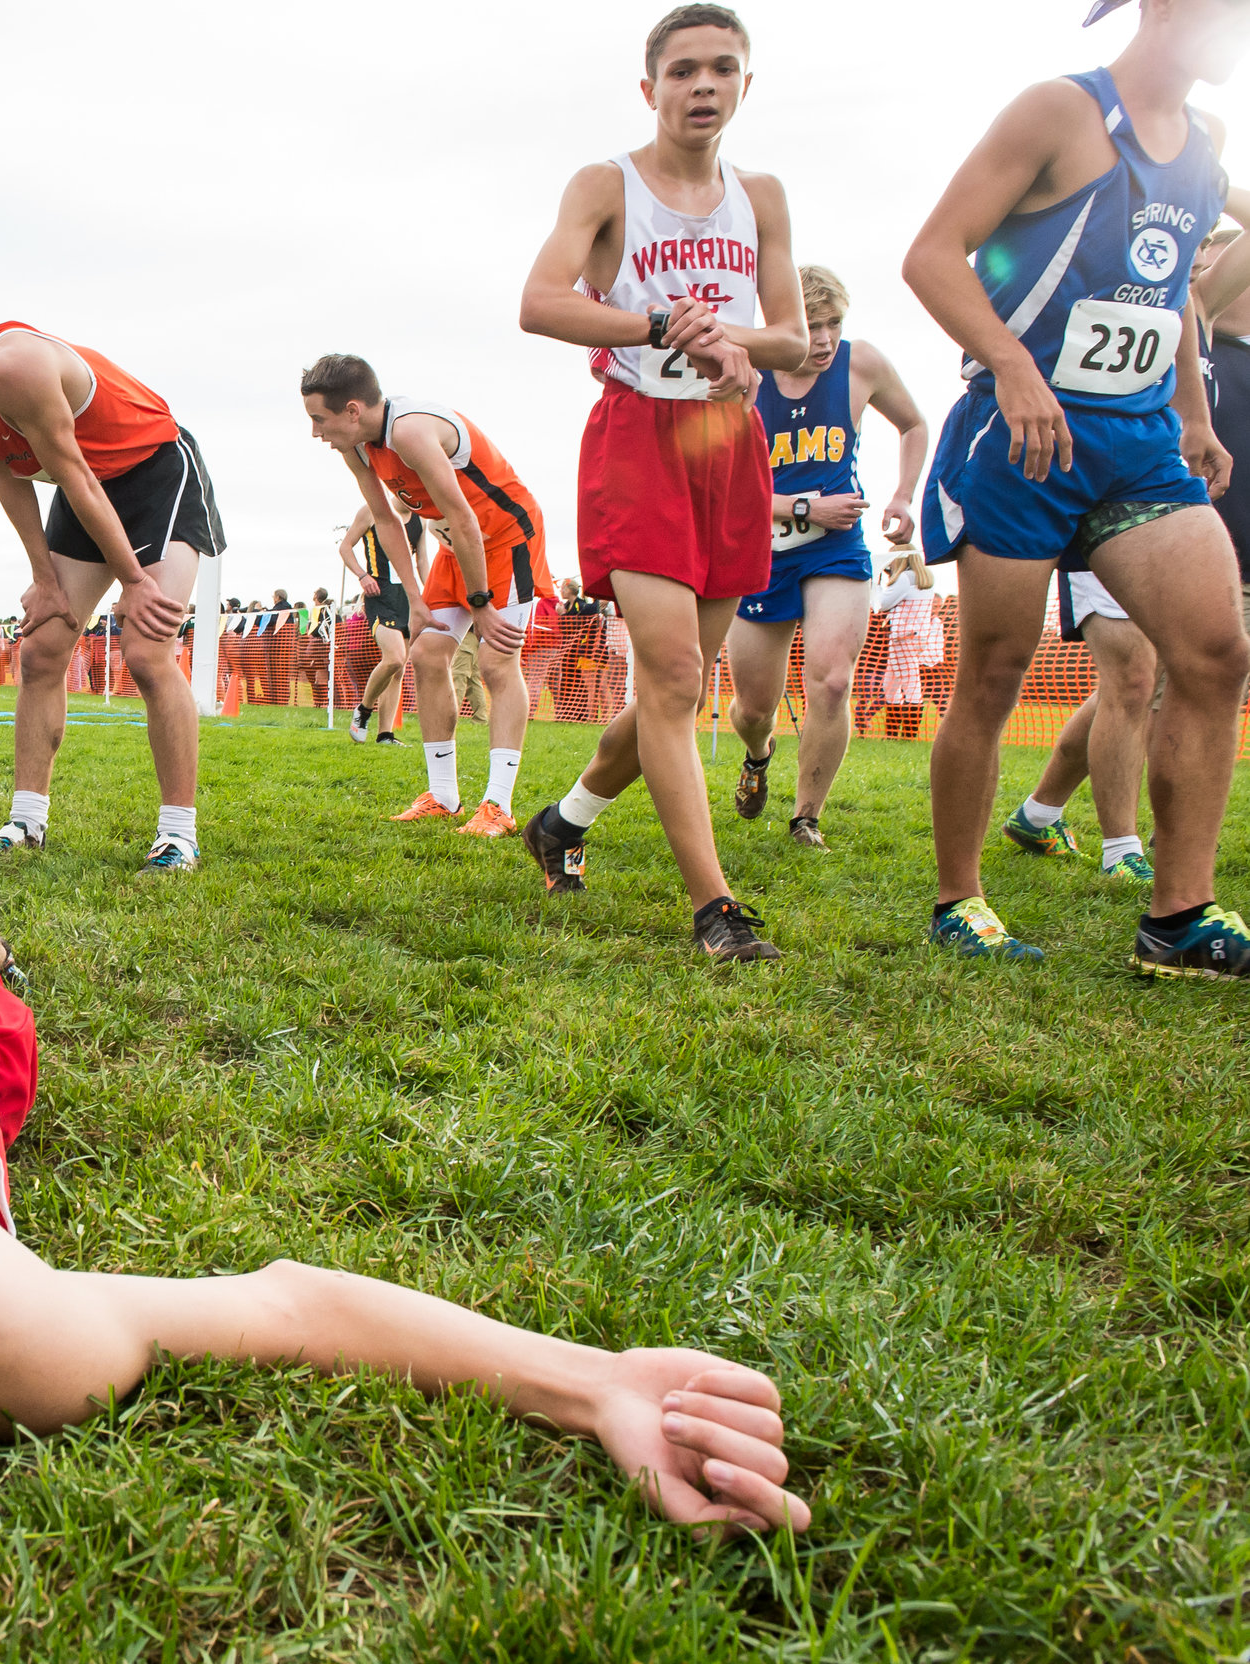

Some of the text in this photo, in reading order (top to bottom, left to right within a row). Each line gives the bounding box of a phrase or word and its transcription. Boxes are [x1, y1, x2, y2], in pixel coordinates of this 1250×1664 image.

[631, 237, 756, 283] WARRIOR
[1079, 323, 1160, 374] 230
[769, 425, 846, 469] AMS
